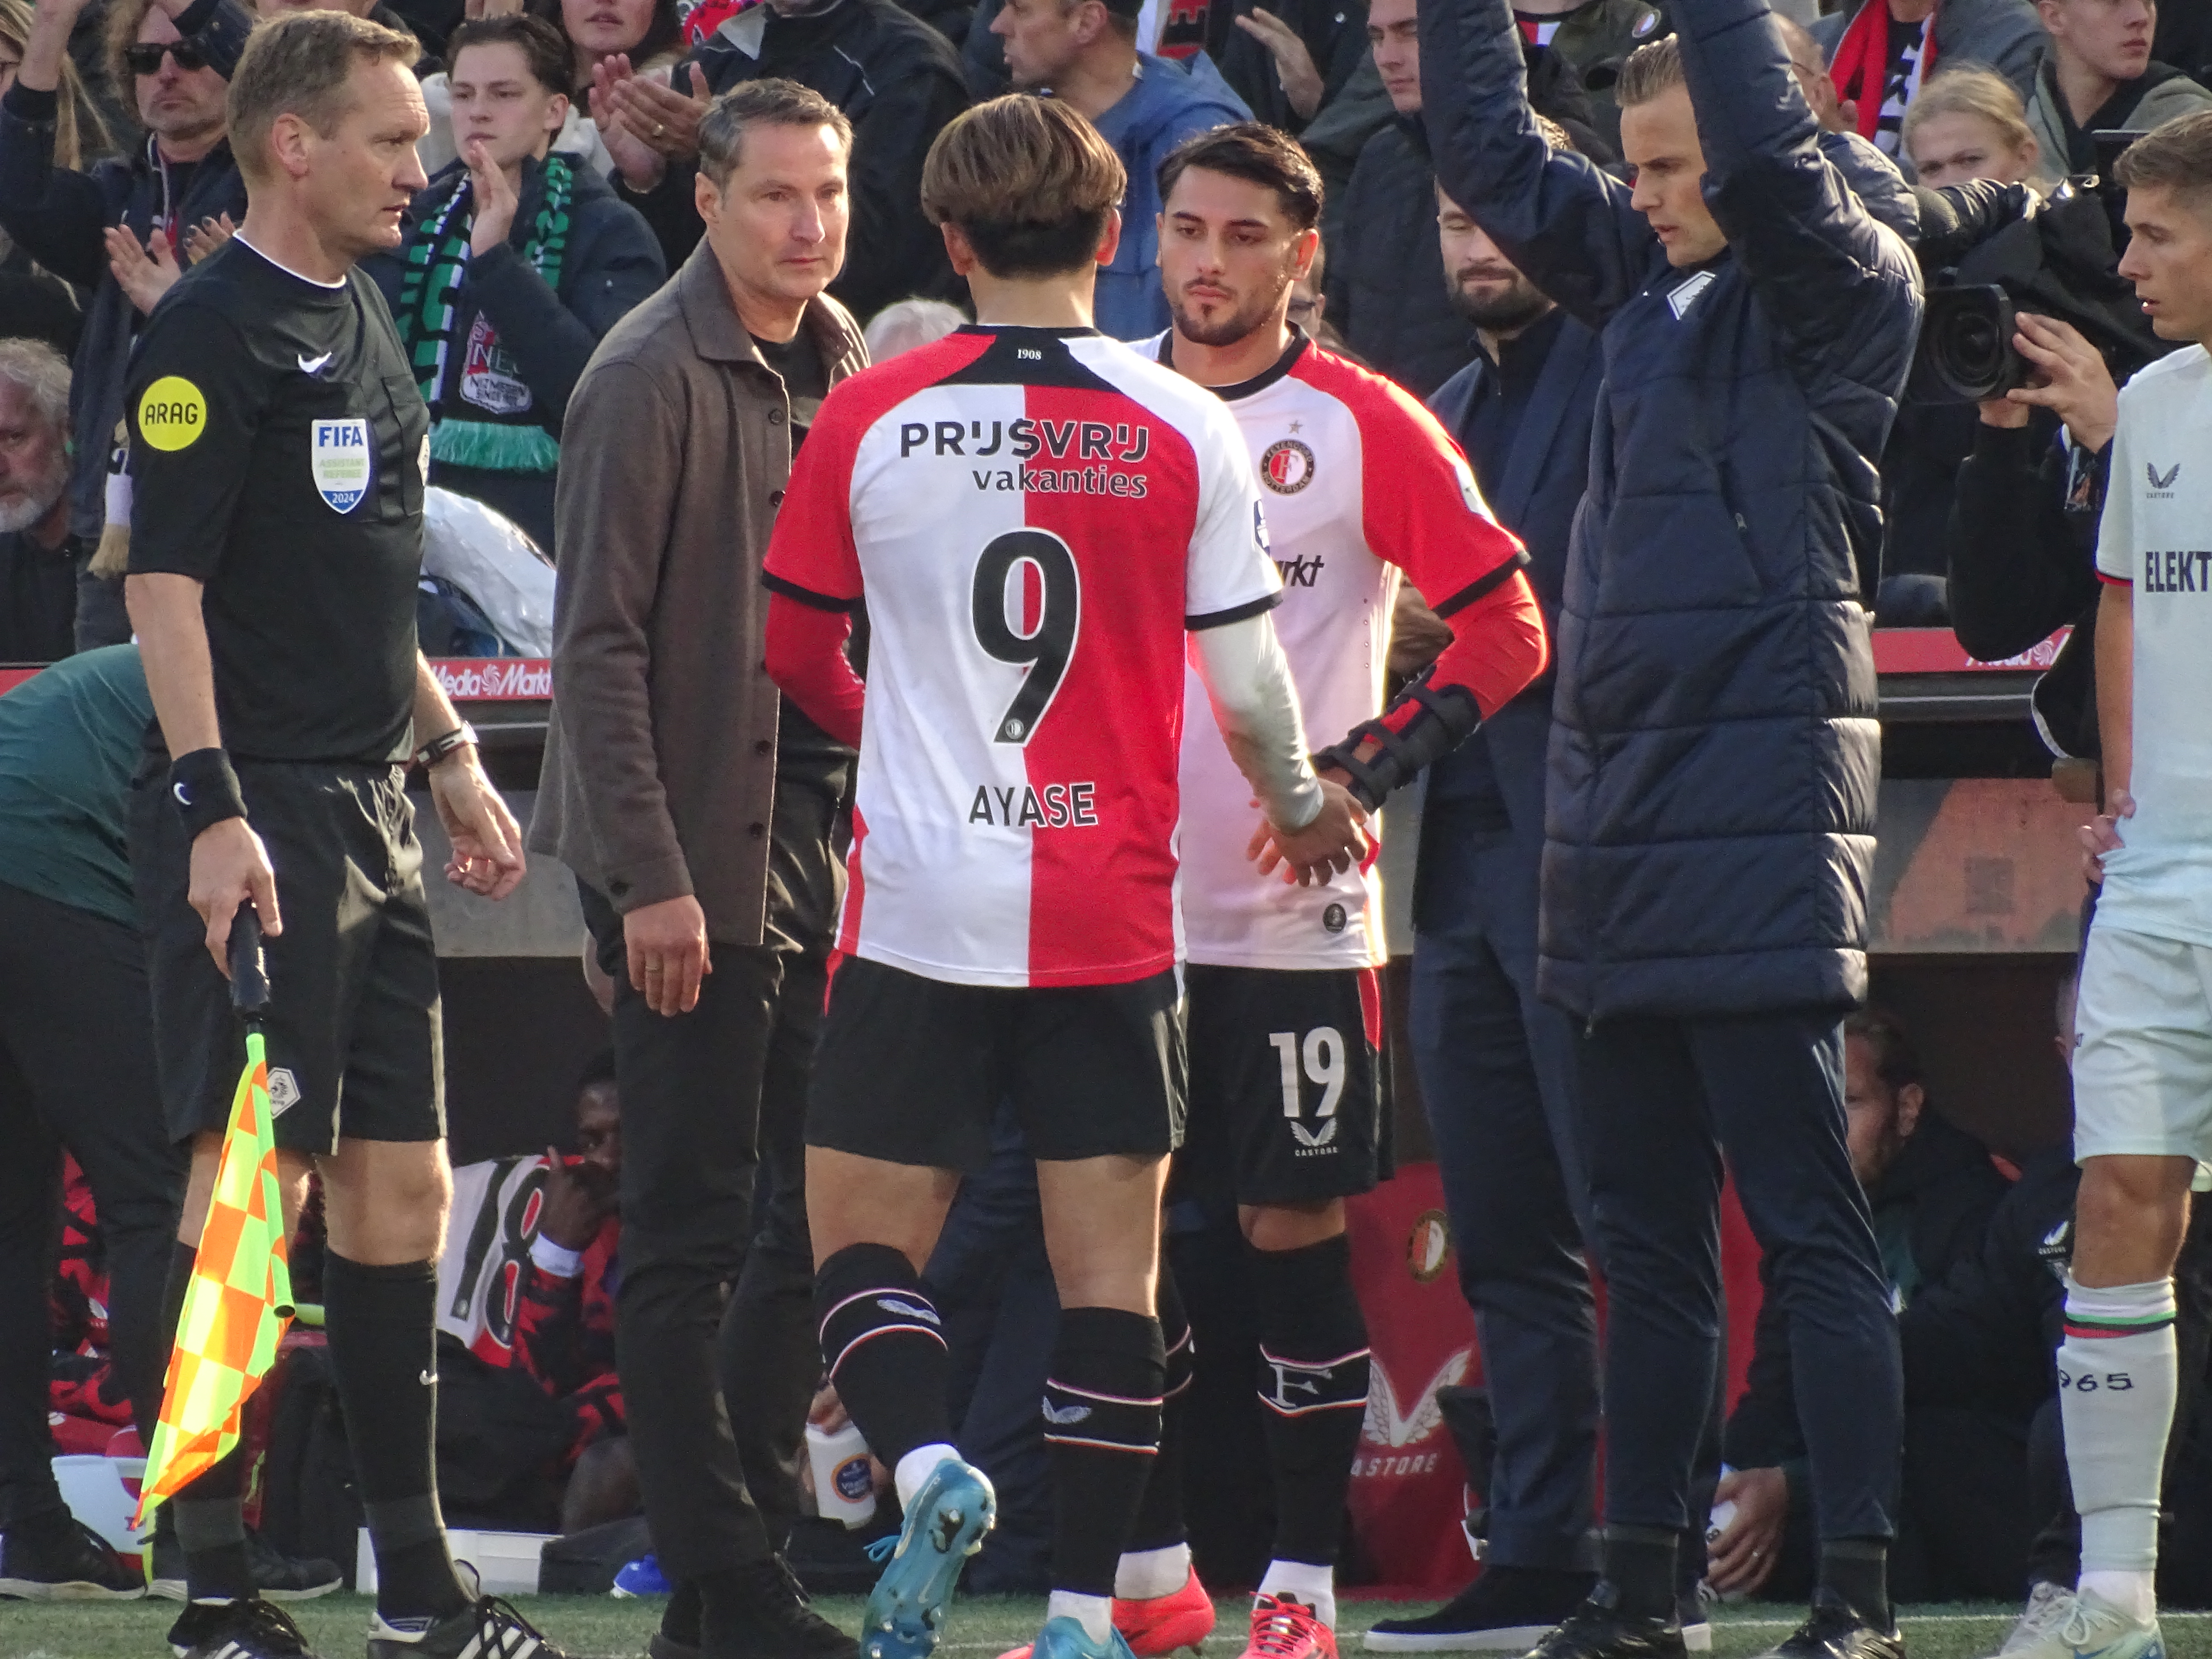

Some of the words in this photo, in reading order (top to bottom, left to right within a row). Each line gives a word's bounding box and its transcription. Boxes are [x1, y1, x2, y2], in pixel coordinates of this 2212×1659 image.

[1017, 348, 1042, 360] 1908
[145, 402, 198, 426] ARAG
[318, 426, 364, 447] FIFA
[900, 418, 1149, 463] PRIJSVRIJ
[332, 492, 354, 504] 2024
[972, 463, 1148, 498] vakanties
[1274, 554, 1325, 587] rkt
[2145, 551, 2212, 592] ELEKT
[971, 527, 1081, 748] 9
[968, 782, 1099, 828] AYASE
[1269, 1026, 1345, 1118] 19
